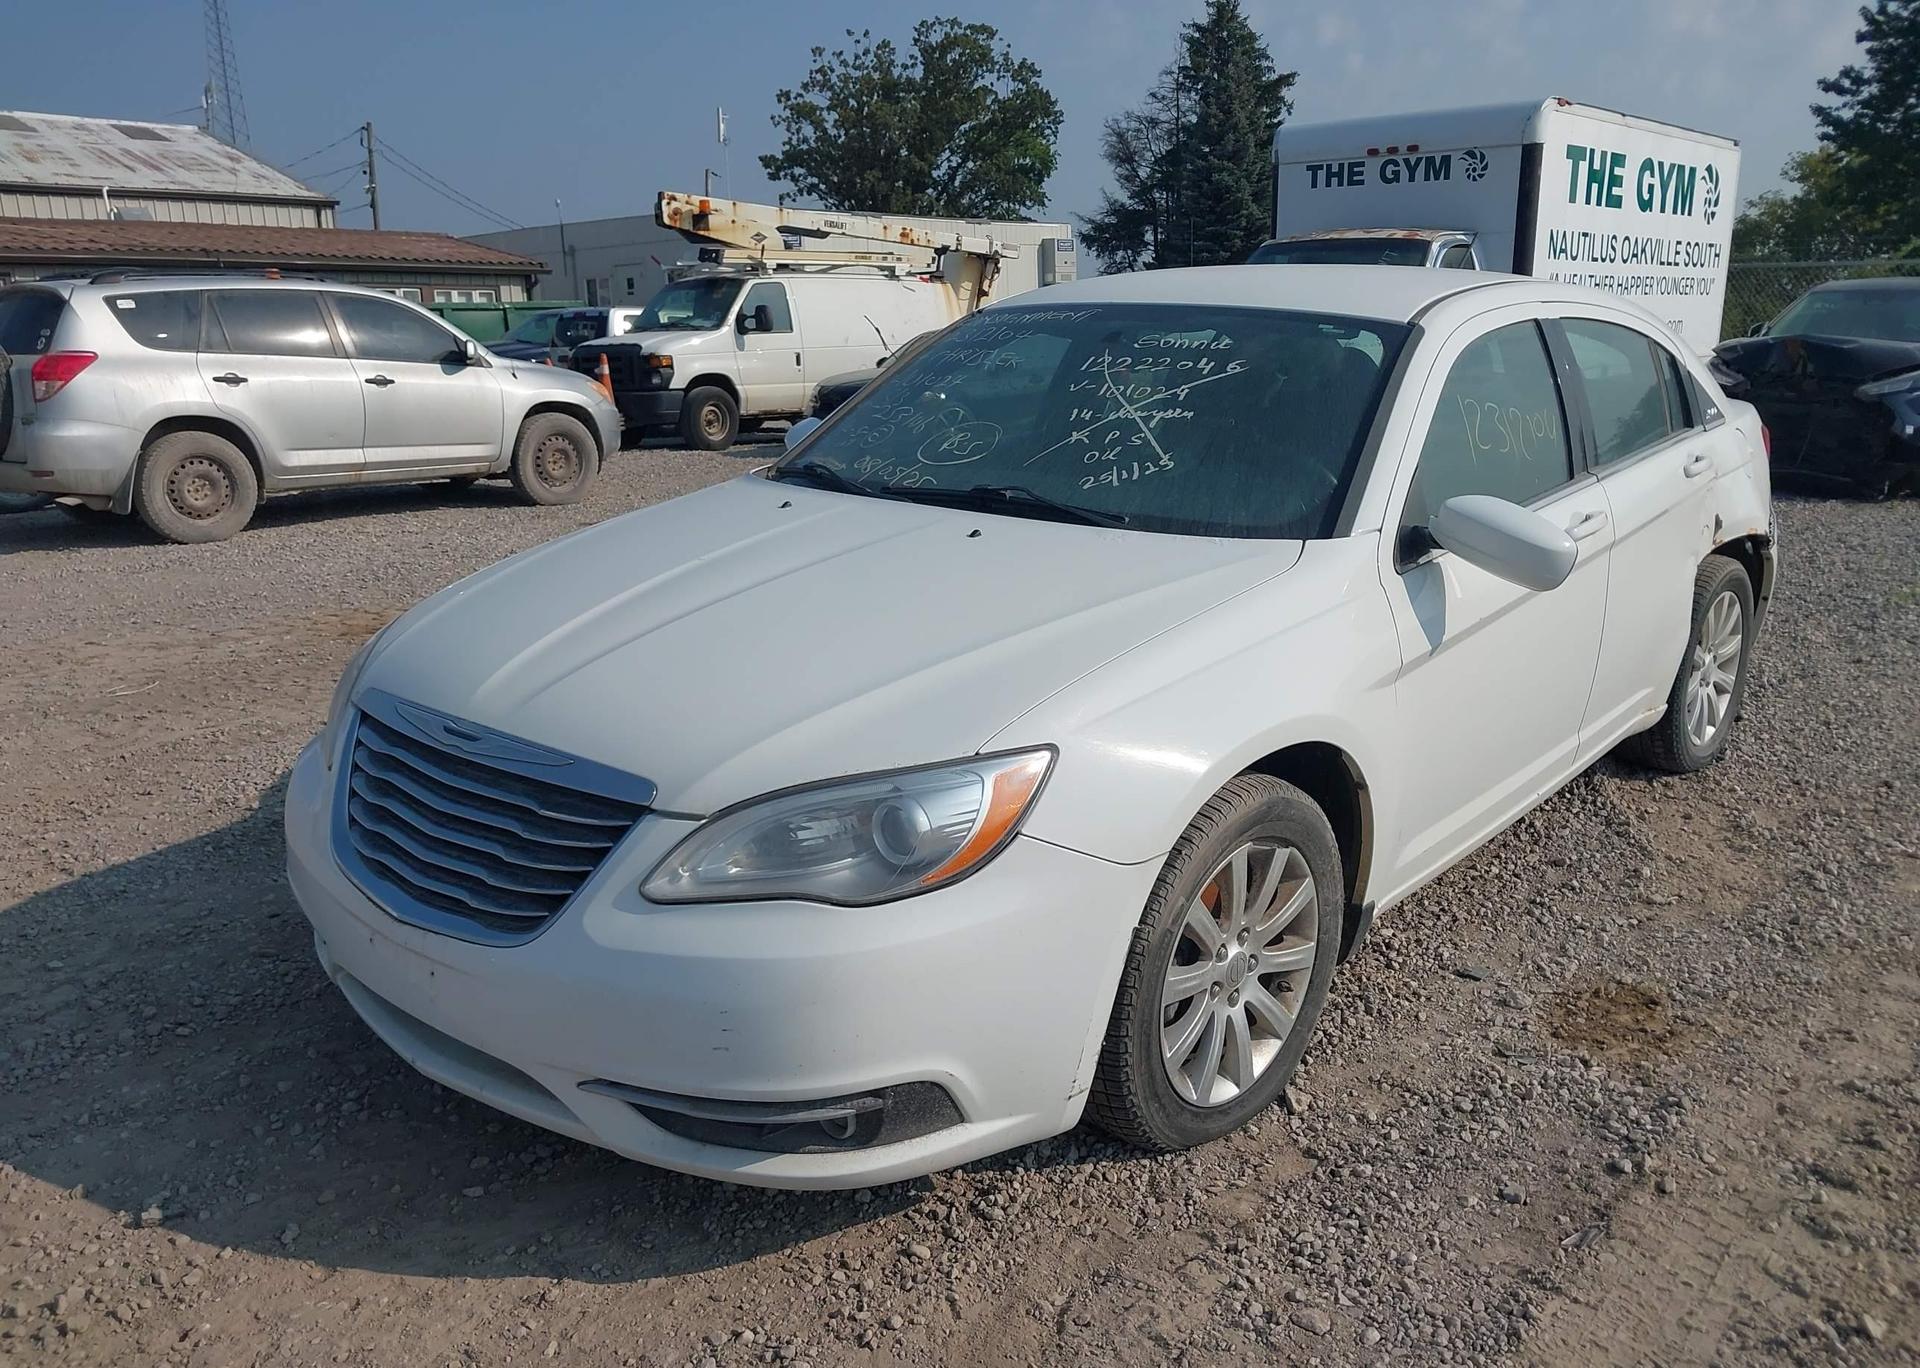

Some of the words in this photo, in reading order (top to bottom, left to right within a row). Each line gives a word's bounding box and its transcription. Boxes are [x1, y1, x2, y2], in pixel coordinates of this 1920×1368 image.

[1306, 161, 1366, 189] THE
[1379, 154, 1452, 185] GYM
[1566, 144, 1627, 209] THE
[1636, 157, 1697, 216] GYM
[1547, 229, 1618, 264] NAUTILUS
[1620, 235, 1682, 267] OAKVILLE
[1683, 241, 1722, 269] SOUTH
[1616, 275, 1654, 296] HAPPIER
[1655, 276, 1695, 296] YOUNGER
